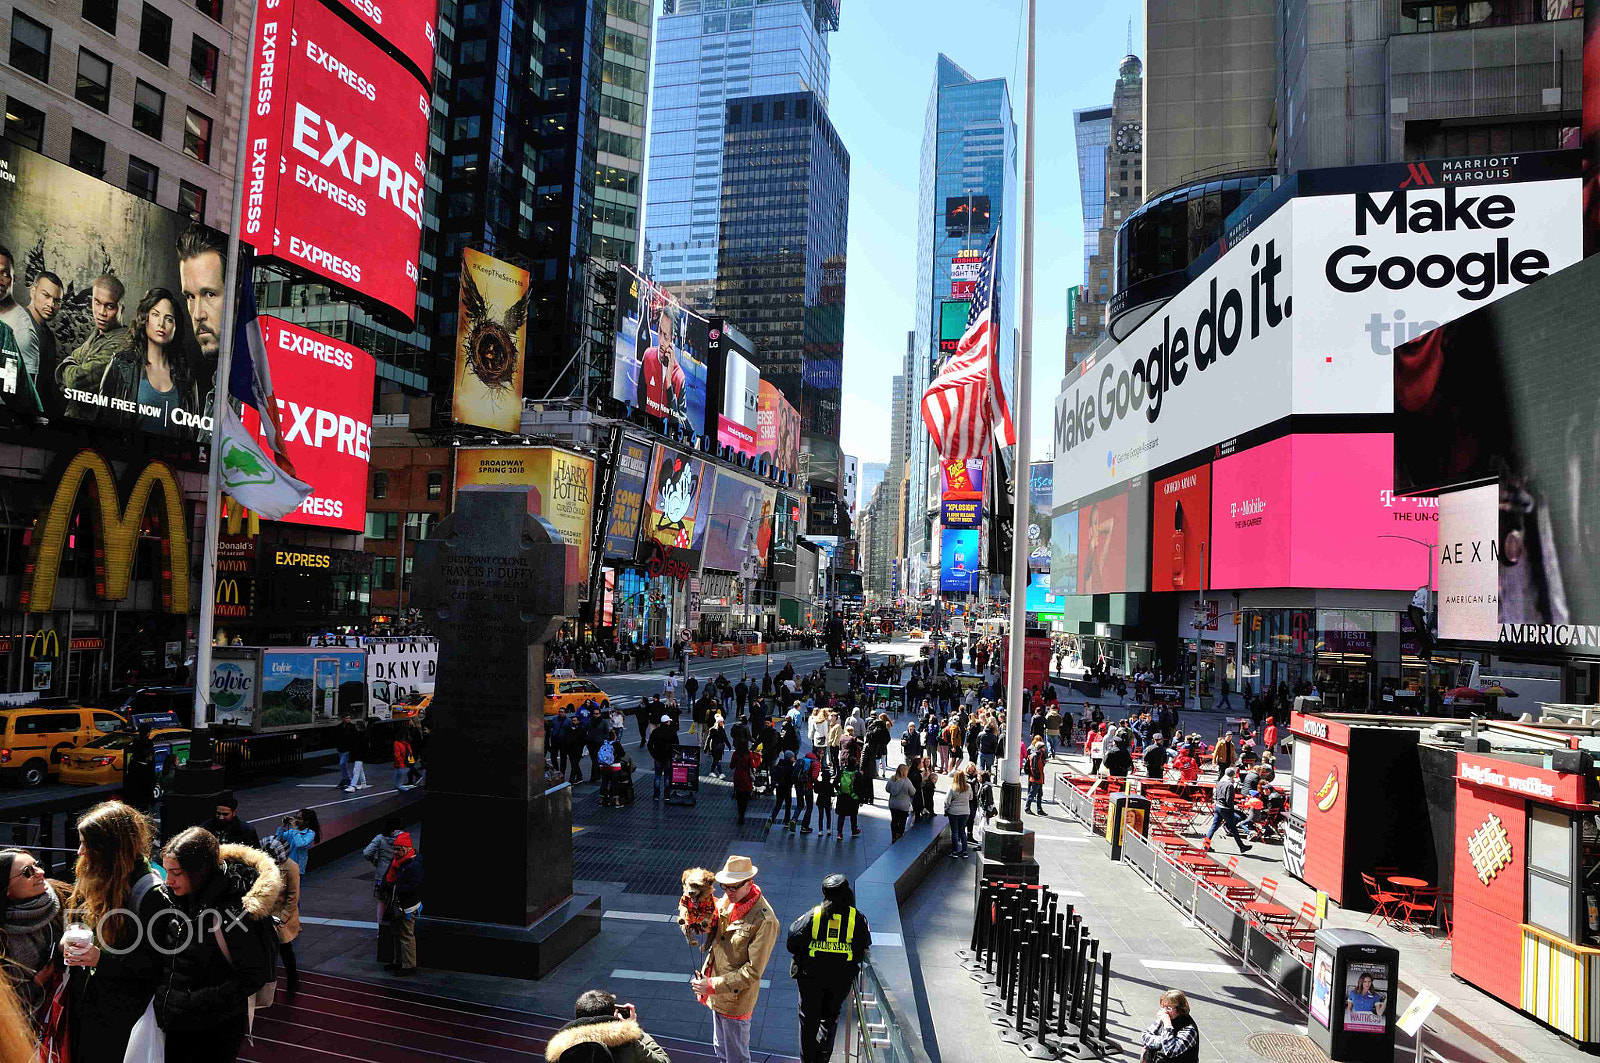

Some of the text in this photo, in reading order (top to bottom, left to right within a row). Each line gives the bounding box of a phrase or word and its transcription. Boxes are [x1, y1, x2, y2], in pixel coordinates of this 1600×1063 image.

[257, 21, 278, 116] EXPRESS
[306, 40, 376, 101] EXPRESS
[1442, 156, 1520, 170] MARRIOTT
[246, 138, 268, 234] EXPRESS
[1442, 169, 1511, 182] MARQUIS
[295, 165, 367, 217] EXPRESS
[1355, 188, 1516, 236] Make
[289, 235, 361, 283] EXPRESS
[957, 249, 979, 258] 2018
[1325, 238, 1551, 302] Google
[279, 329, 353, 370] EXPRESS
[709, 341, 719, 349] LG
[1054, 379, 1096, 454] Make
[1097, 314, 1189, 425] Google
[1194, 276, 1244, 372] do
[1250, 238, 1293, 340] it.
[64, 387, 162, 418] STREAM FREE NOW
[646, 396, 660, 411] Happy
[660, 403, 670, 414] New
[1129, 446, 1142, 459] Google
[1142, 437, 1159, 453] Assistant
[556, 458, 590, 486] HARRY
[553, 477, 590, 505] POTTER
[1163, 474, 1197, 495] GIORGIO ARMANI
[615, 489, 641, 508] COME
[556, 503, 586, 516] CURSED CHILD
[1393, 512, 1412, 521] THE
[609, 520, 637, 538] AWAY
[275, 551, 331, 568] EXPRESS
[447, 555, 528, 566] LIEUTENANT COLONEL
[1441, 543, 1463, 565] AE
[1471, 541, 1481, 563] X
[441, 565, 484, 577] FRANCIS
[498, 567, 536, 579] DUFFY
[1445, 595, 1484, 604] AMERICAN
[1499, 623, 1600, 647] AMERICAN
[272, 662, 293, 673] Volvic
[376, 660, 421, 679] DKNY
[1461, 763, 1555, 797] belgian waffles
[1350, 1012, 1381, 1024] WAITRESS
